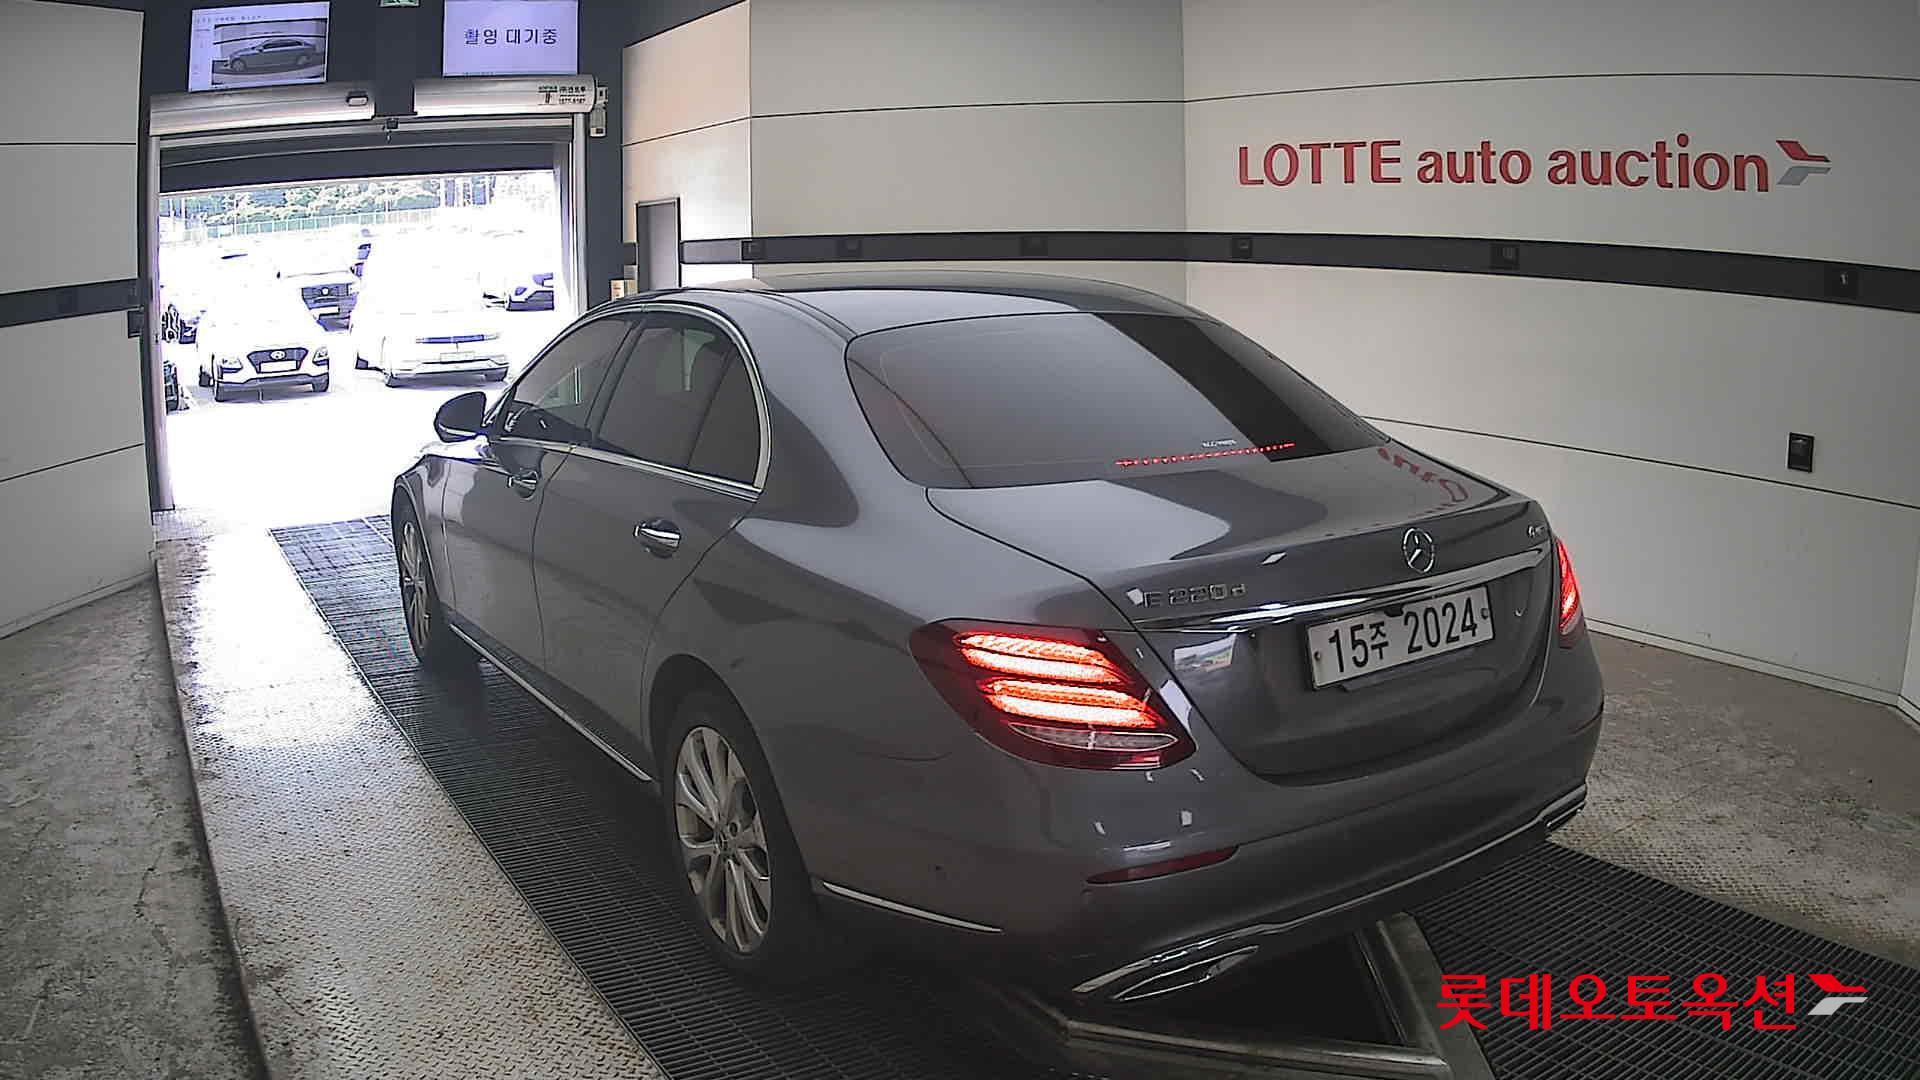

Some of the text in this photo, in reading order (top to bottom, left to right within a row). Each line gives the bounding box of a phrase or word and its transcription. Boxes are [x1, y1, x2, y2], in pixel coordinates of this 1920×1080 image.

[506, 28, 557, 45] 대기중
[1239, 134, 1768, 192] LOTTE auto auction
[1328, 597, 1478, 673] 15주 2024
